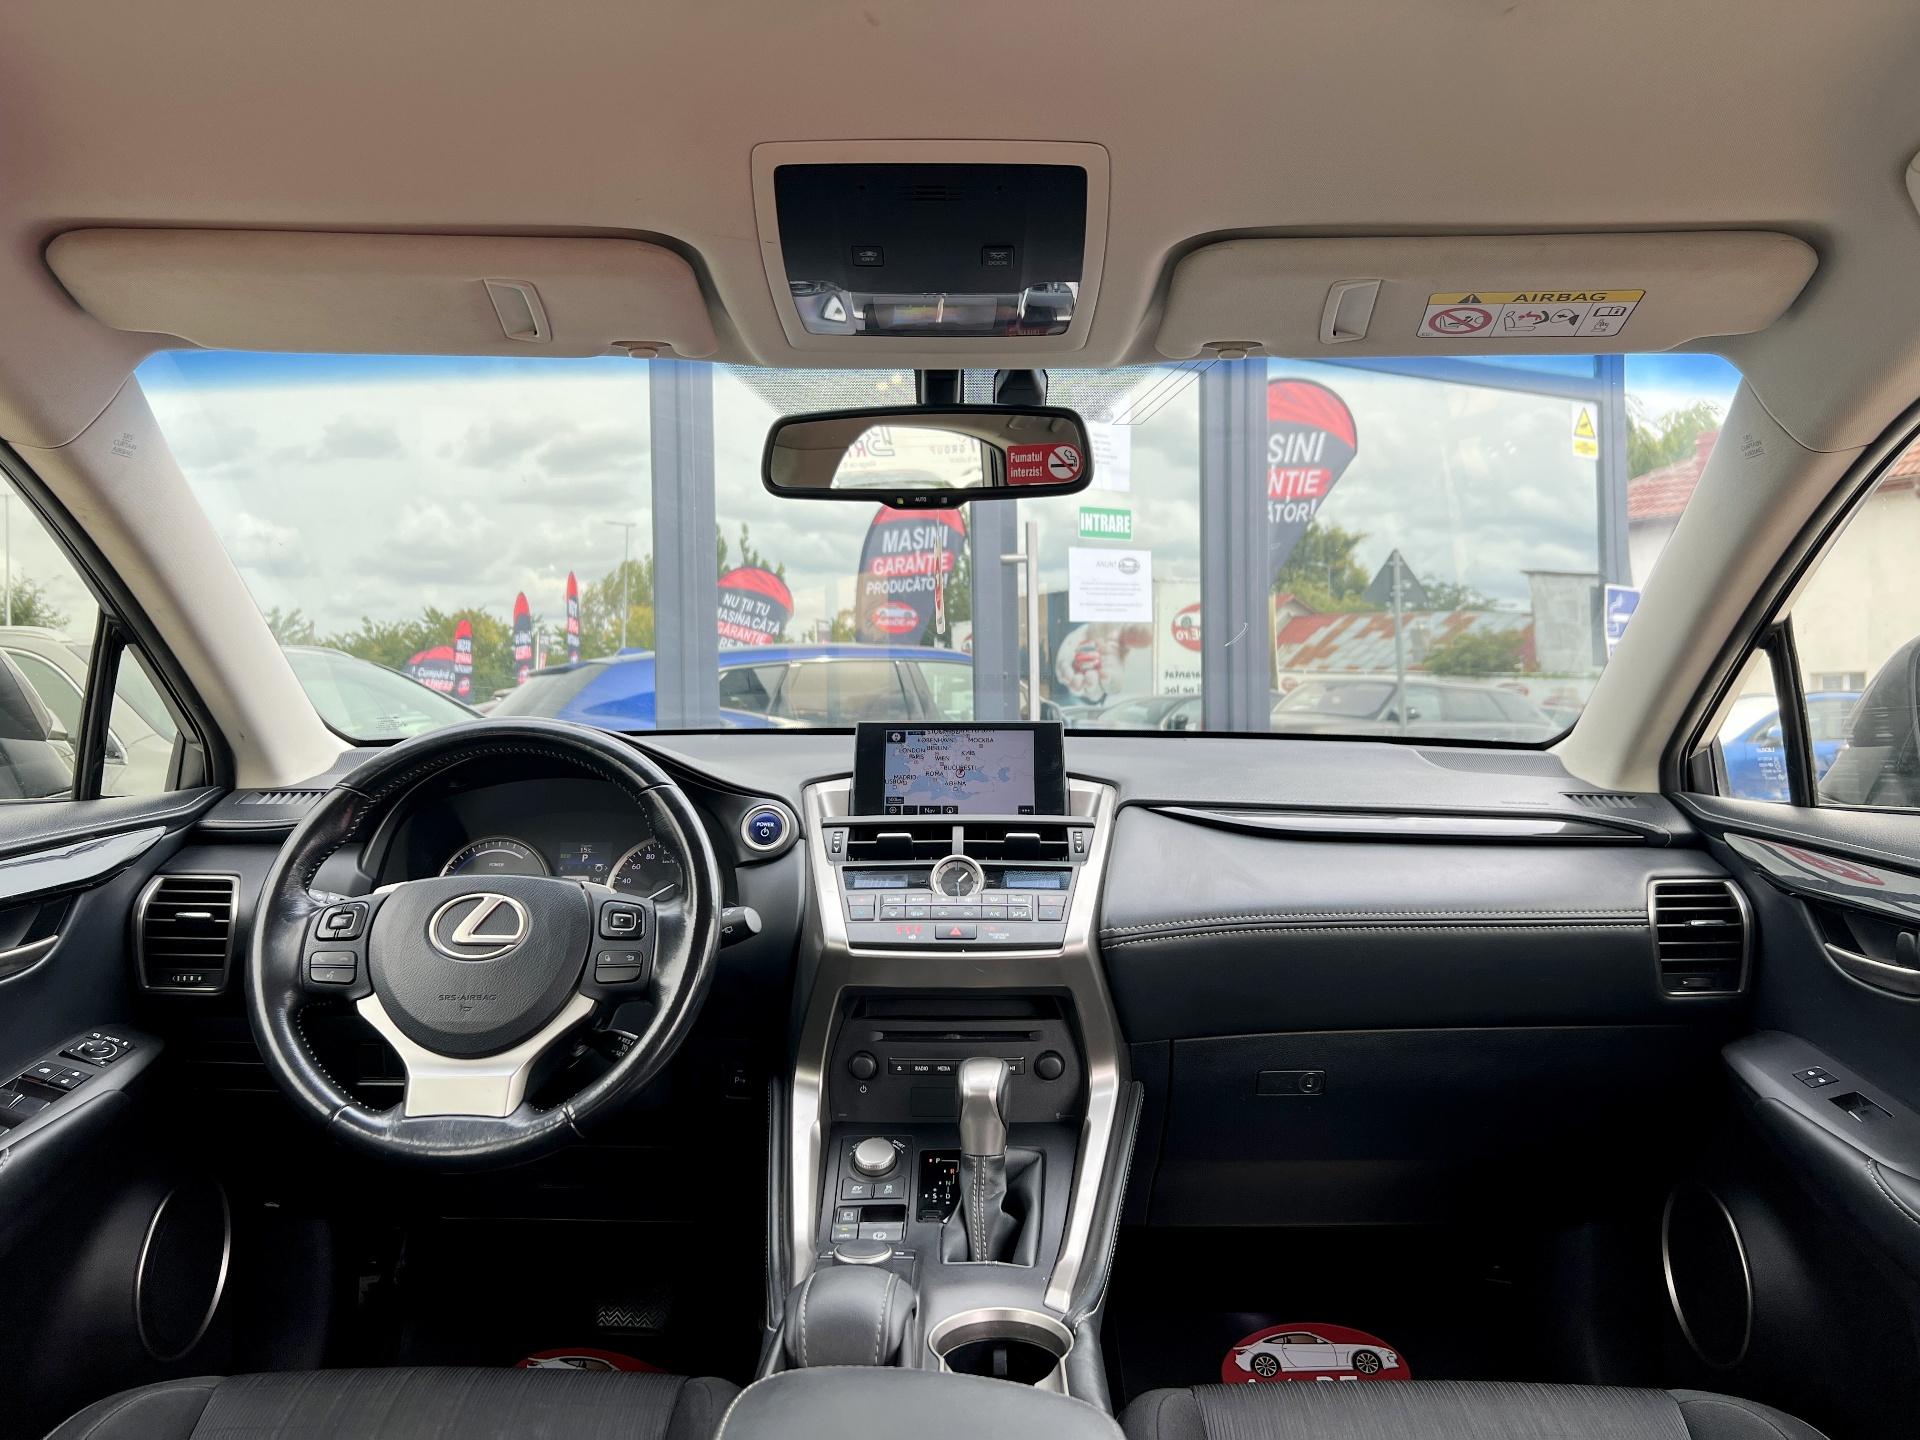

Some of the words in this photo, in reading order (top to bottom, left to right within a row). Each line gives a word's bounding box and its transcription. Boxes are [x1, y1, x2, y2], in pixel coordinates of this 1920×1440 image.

[1512, 292, 1607, 303] AIRBAG
[1010, 452, 1043, 463] Fumatul
[1010, 466, 1043, 478] interzis!
[1080, 512, 1131, 534] INTRARE
[872, 552, 948, 577] GARANȚE
[723, 592, 740, 608] NU
[756, 601, 771, 617] TU
[581, 854, 588, 862] P
[103, 1035, 120, 1043] AUTO
